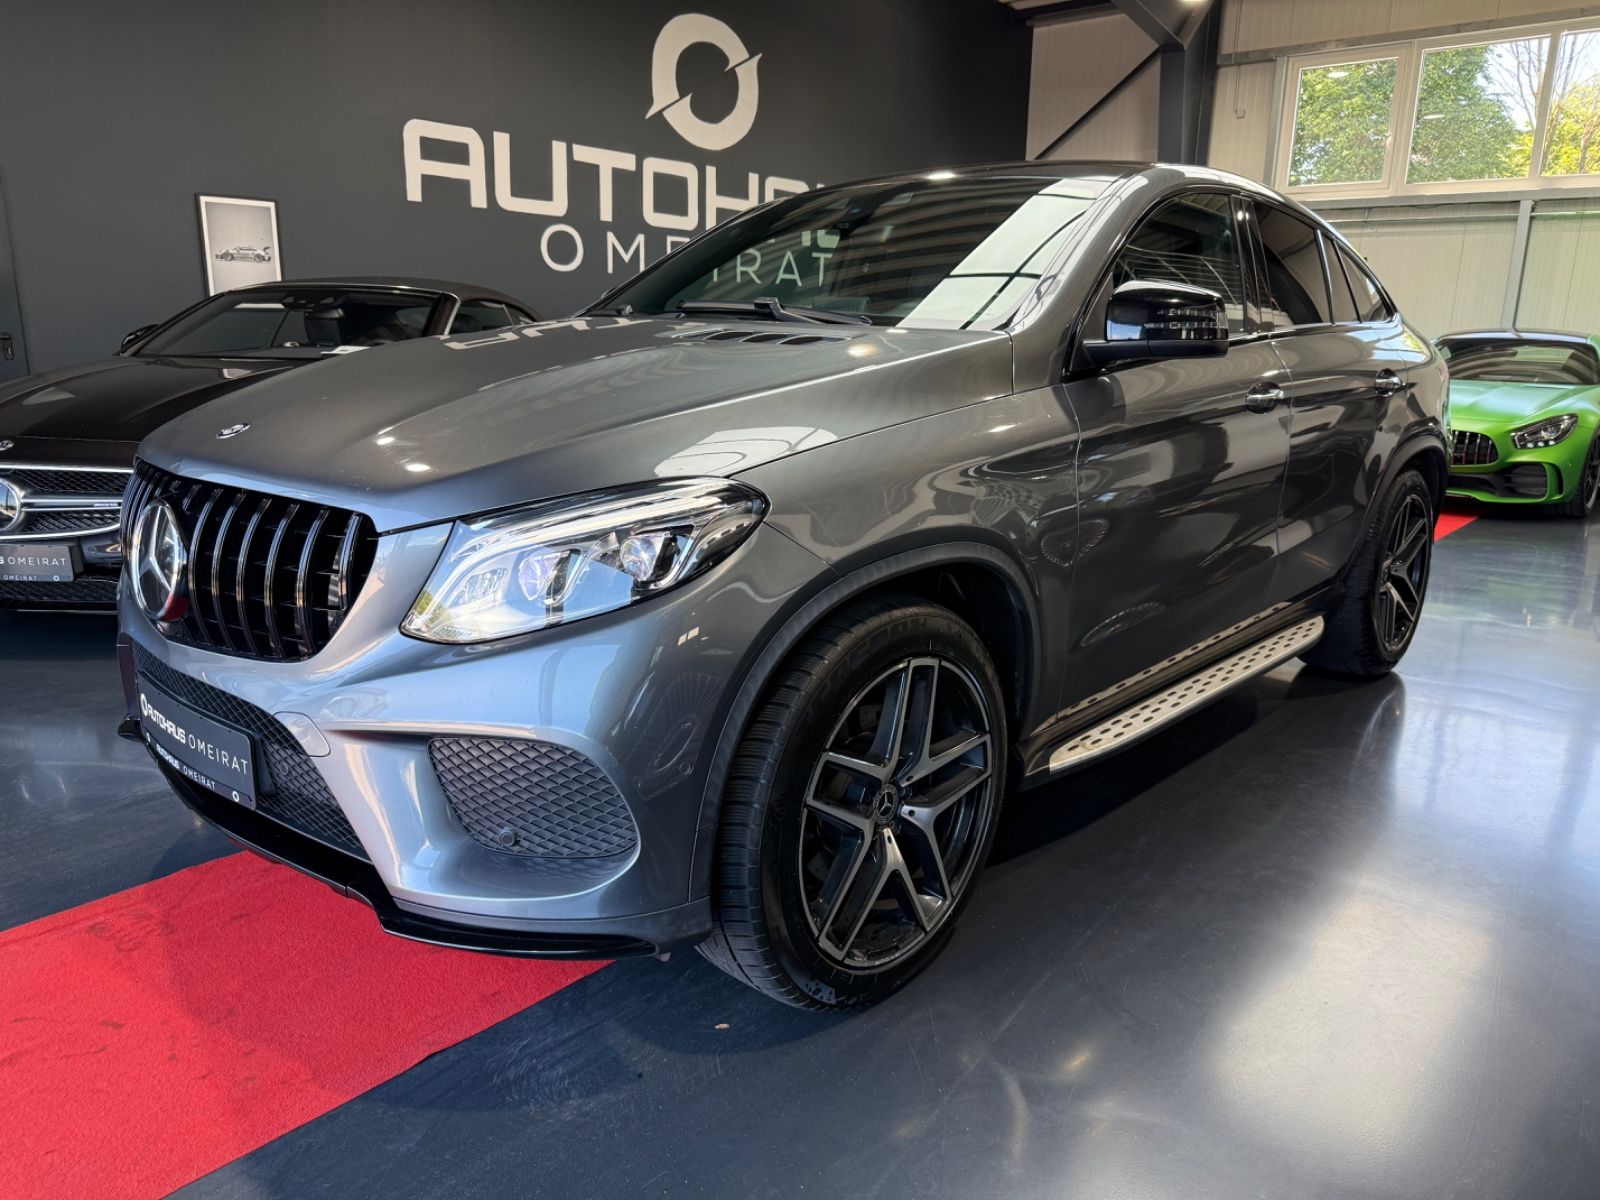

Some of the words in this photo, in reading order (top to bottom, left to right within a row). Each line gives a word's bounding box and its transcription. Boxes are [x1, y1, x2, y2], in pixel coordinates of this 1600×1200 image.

[7, 556, 66, 566] OMEIRAT
[147, 703, 187, 745] AUTOHAUS
[188, 734, 249, 775] OMEIRAT
[183, 765, 216, 790] OMEIRAT
